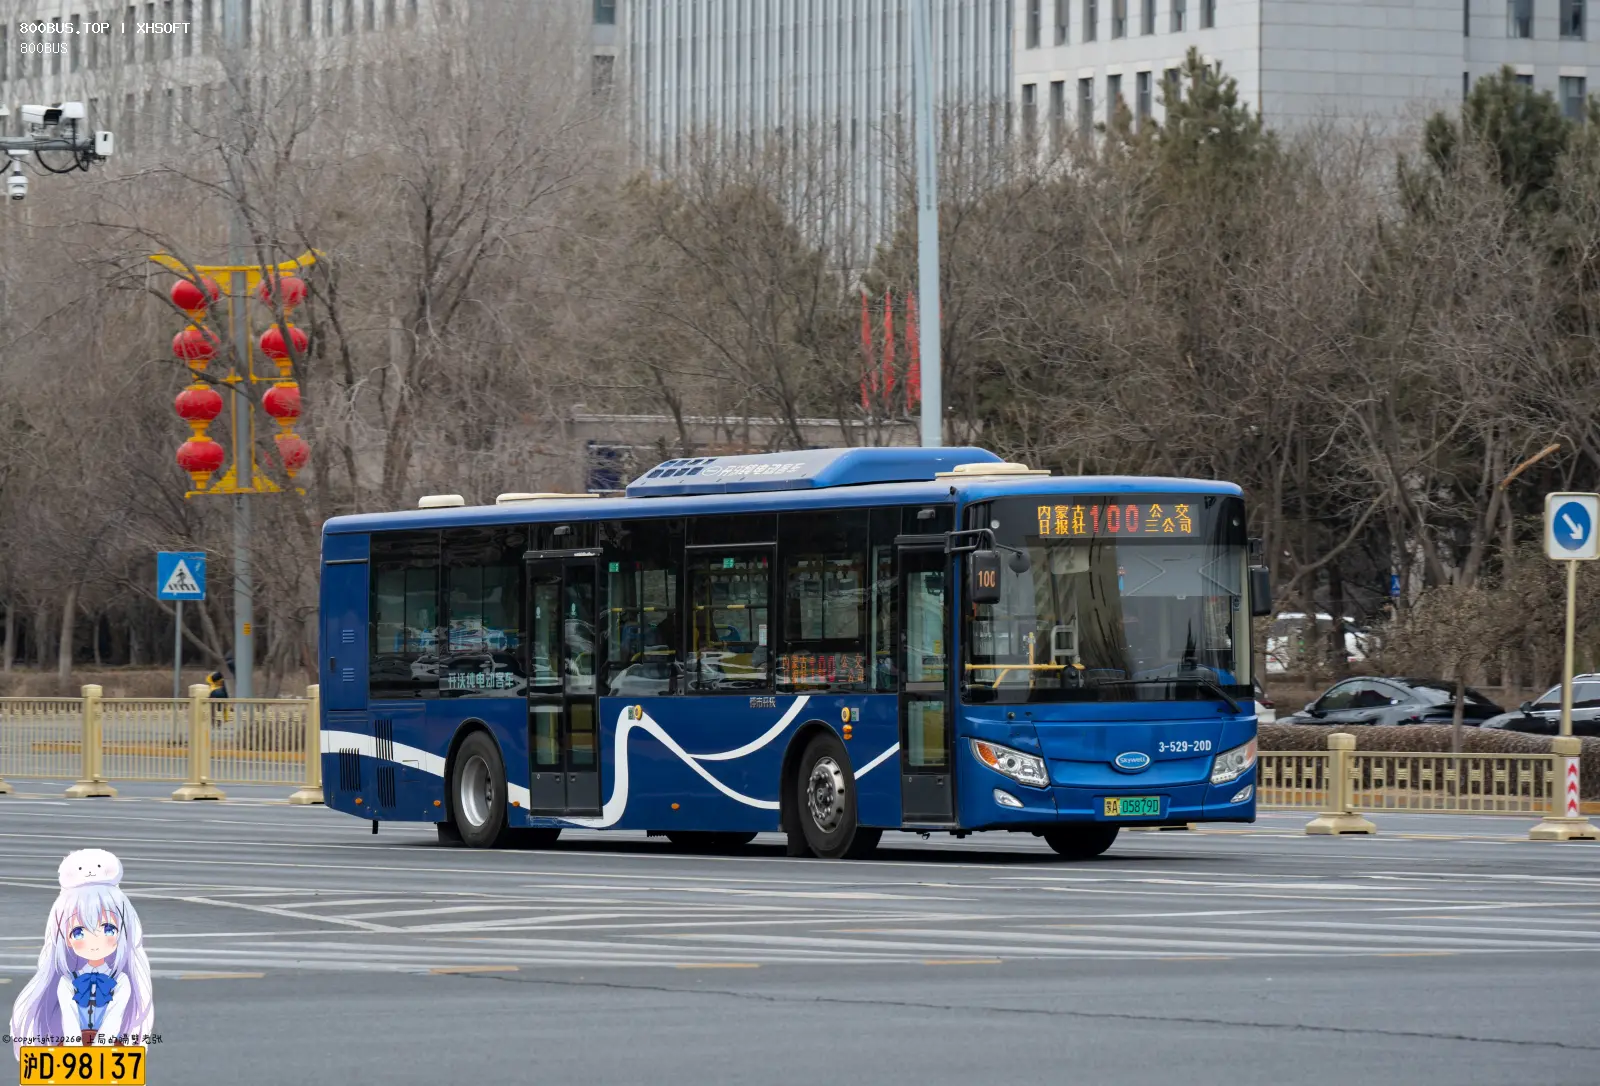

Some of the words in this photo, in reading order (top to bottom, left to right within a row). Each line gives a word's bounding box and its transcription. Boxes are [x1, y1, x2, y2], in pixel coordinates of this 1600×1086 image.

[1037, 504, 1085, 520] 内蒙古
[1090, 504, 1139, 533] 100
[1039, 519, 1086, 535] 日报社
[1145, 518, 1192, 534] 三公司
[448, 672, 514, 689] 开沃纯电动客车
[1158, 740, 1212, 753] 3-529-20D
[1119, 756, 1146, 764] Skywell
